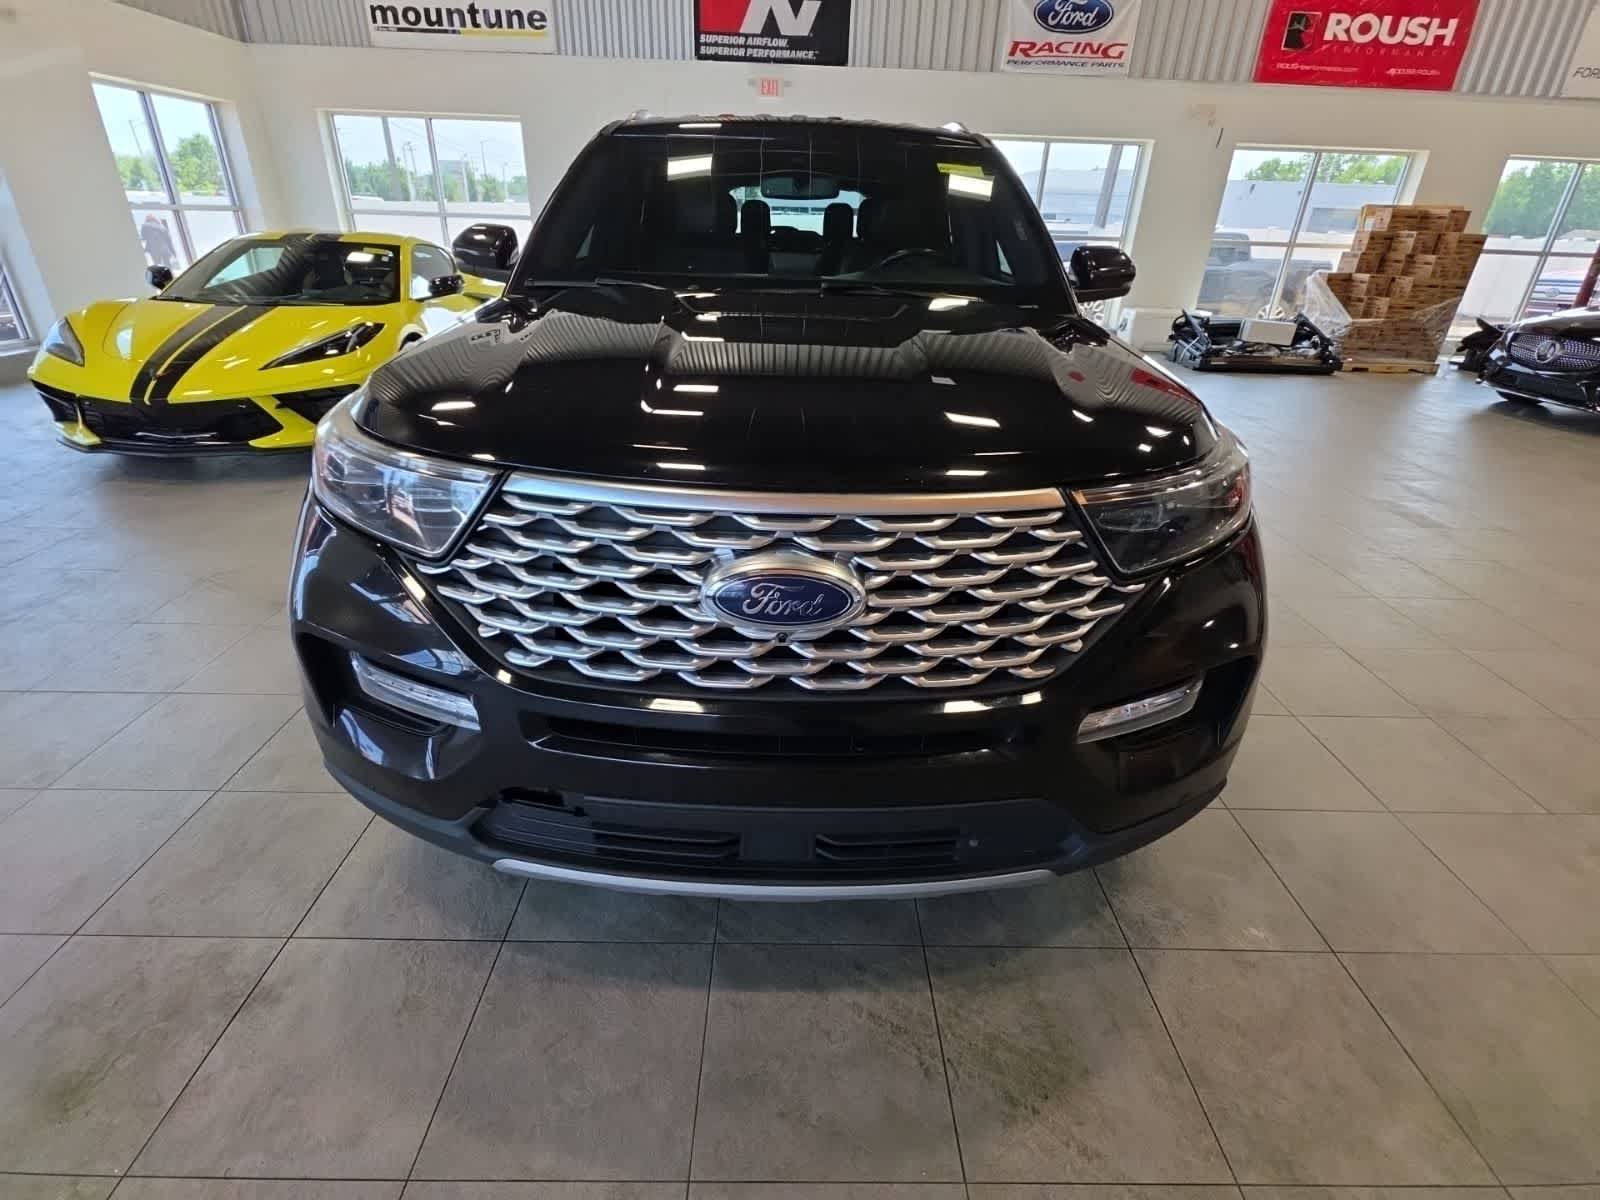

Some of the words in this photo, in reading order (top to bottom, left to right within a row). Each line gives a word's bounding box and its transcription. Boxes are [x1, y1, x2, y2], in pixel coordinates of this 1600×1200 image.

[369, 2, 548, 30] mountune
[1047, 0, 1099, 26] Ford
[1323, 12, 1458, 46] ROUSH
[699, 34, 745, 46] SUPERIOR
[746, 37, 789, 48] AIRFLOW.
[699, 45, 745, 57] SUPERIOR
[1007, 41, 1128, 59] RACING
[761, 79, 779, 97] EXIT
[742, 582, 825, 616] Ford
